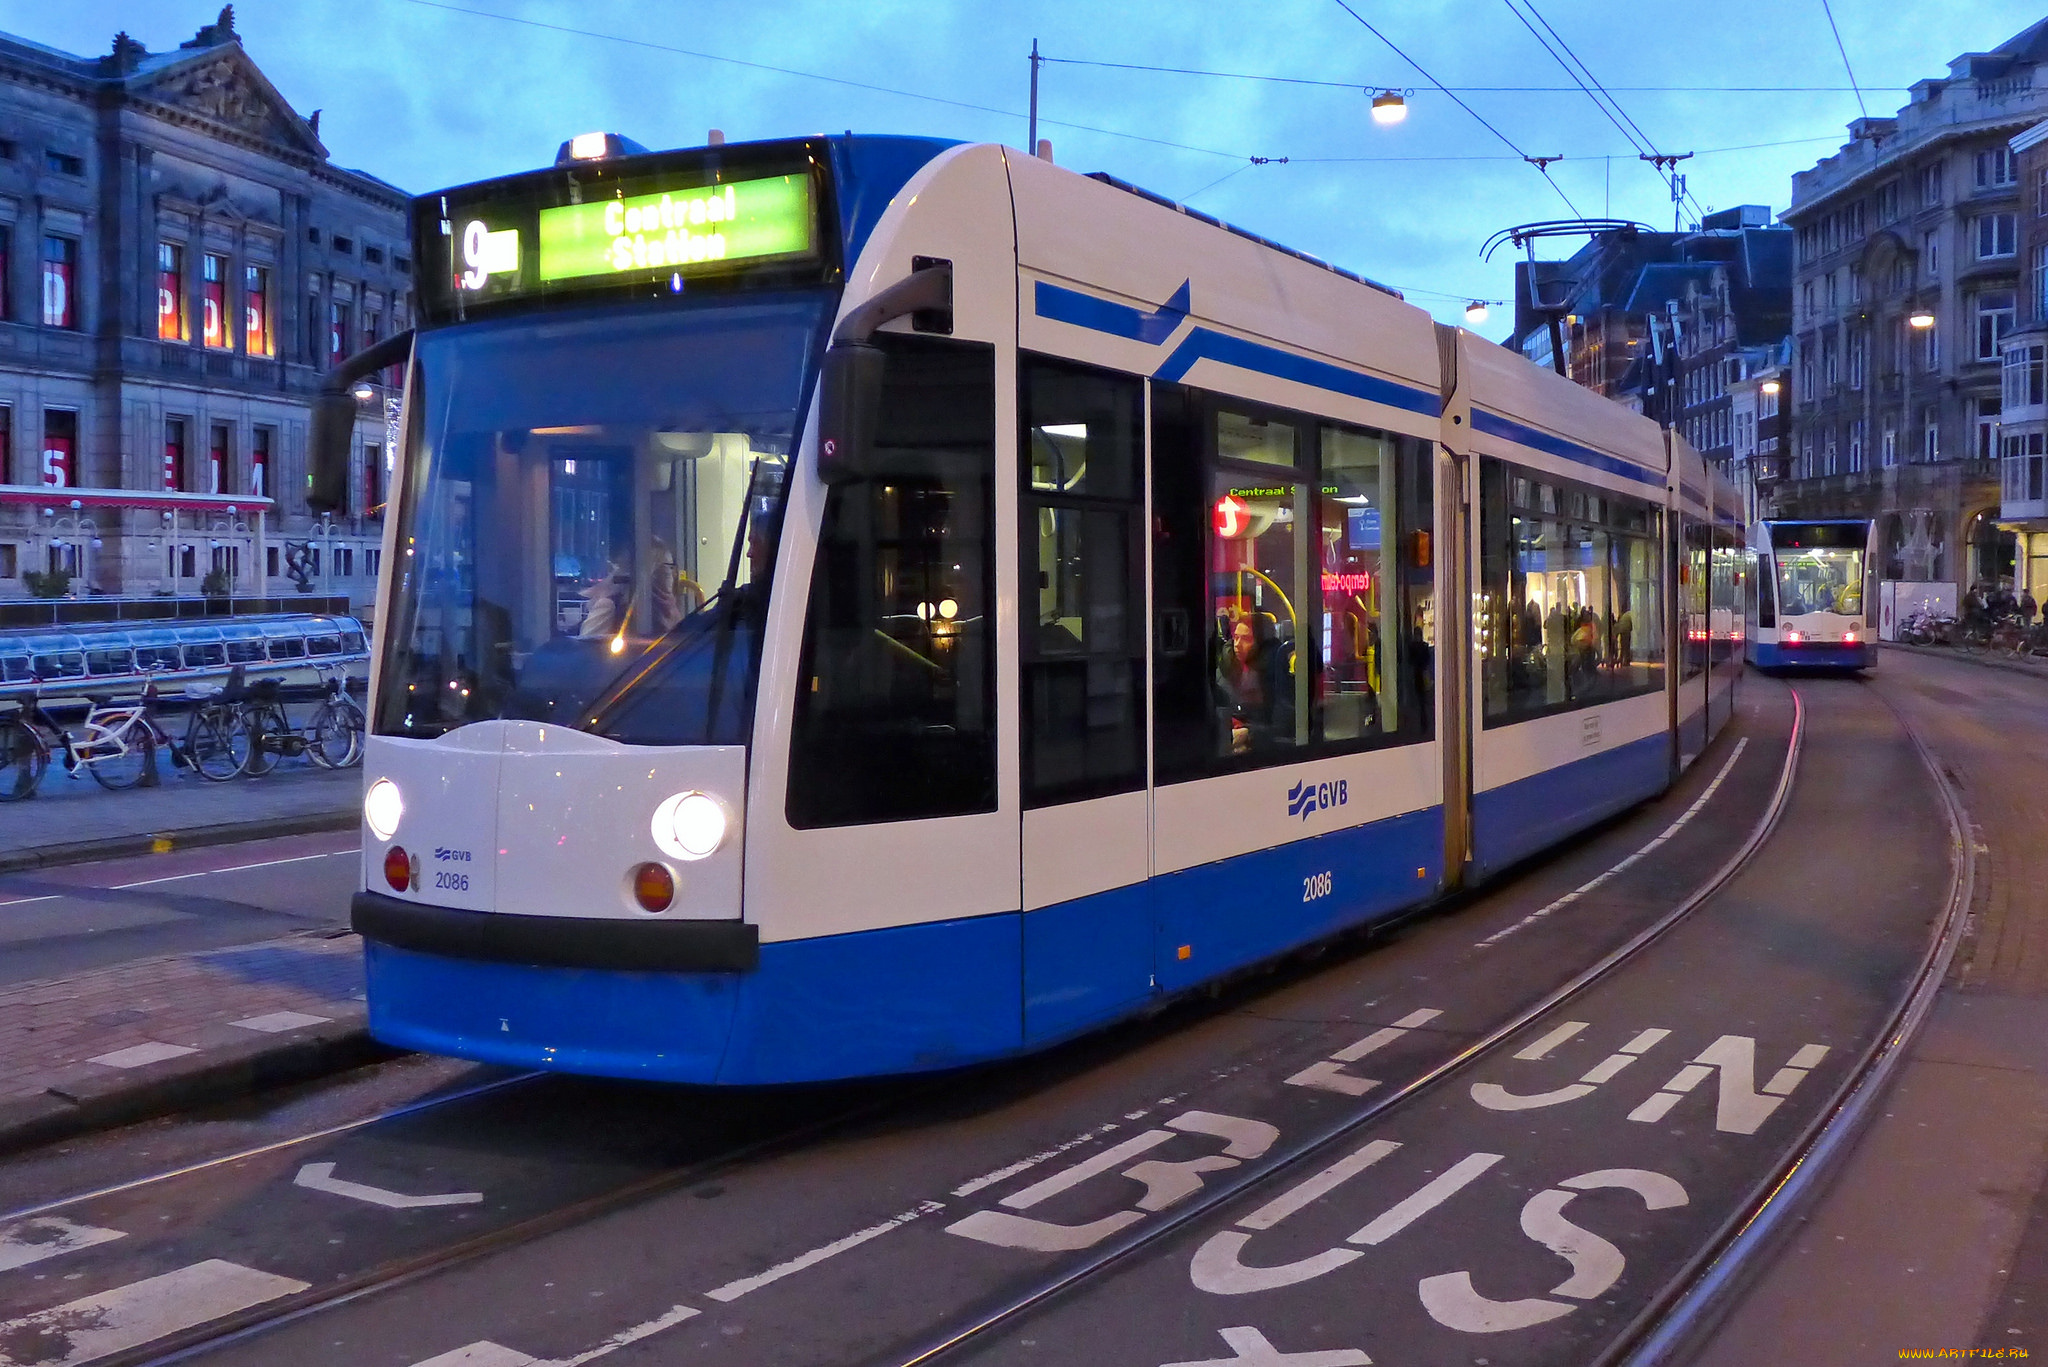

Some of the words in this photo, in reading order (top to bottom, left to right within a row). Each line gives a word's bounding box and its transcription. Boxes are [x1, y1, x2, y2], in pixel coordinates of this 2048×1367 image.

[463, 220, 488, 289] 9
[612, 228, 725, 270] Station
[1230, 487, 1285, 497] Centraal
[1318, 779, 1348, 810] GVB
[452, 850, 471, 862] GVB
[435, 871, 469, 892] 2086
[1303, 871, 1332, 903] 2086
[944, 1110, 1690, 1333] BUS
